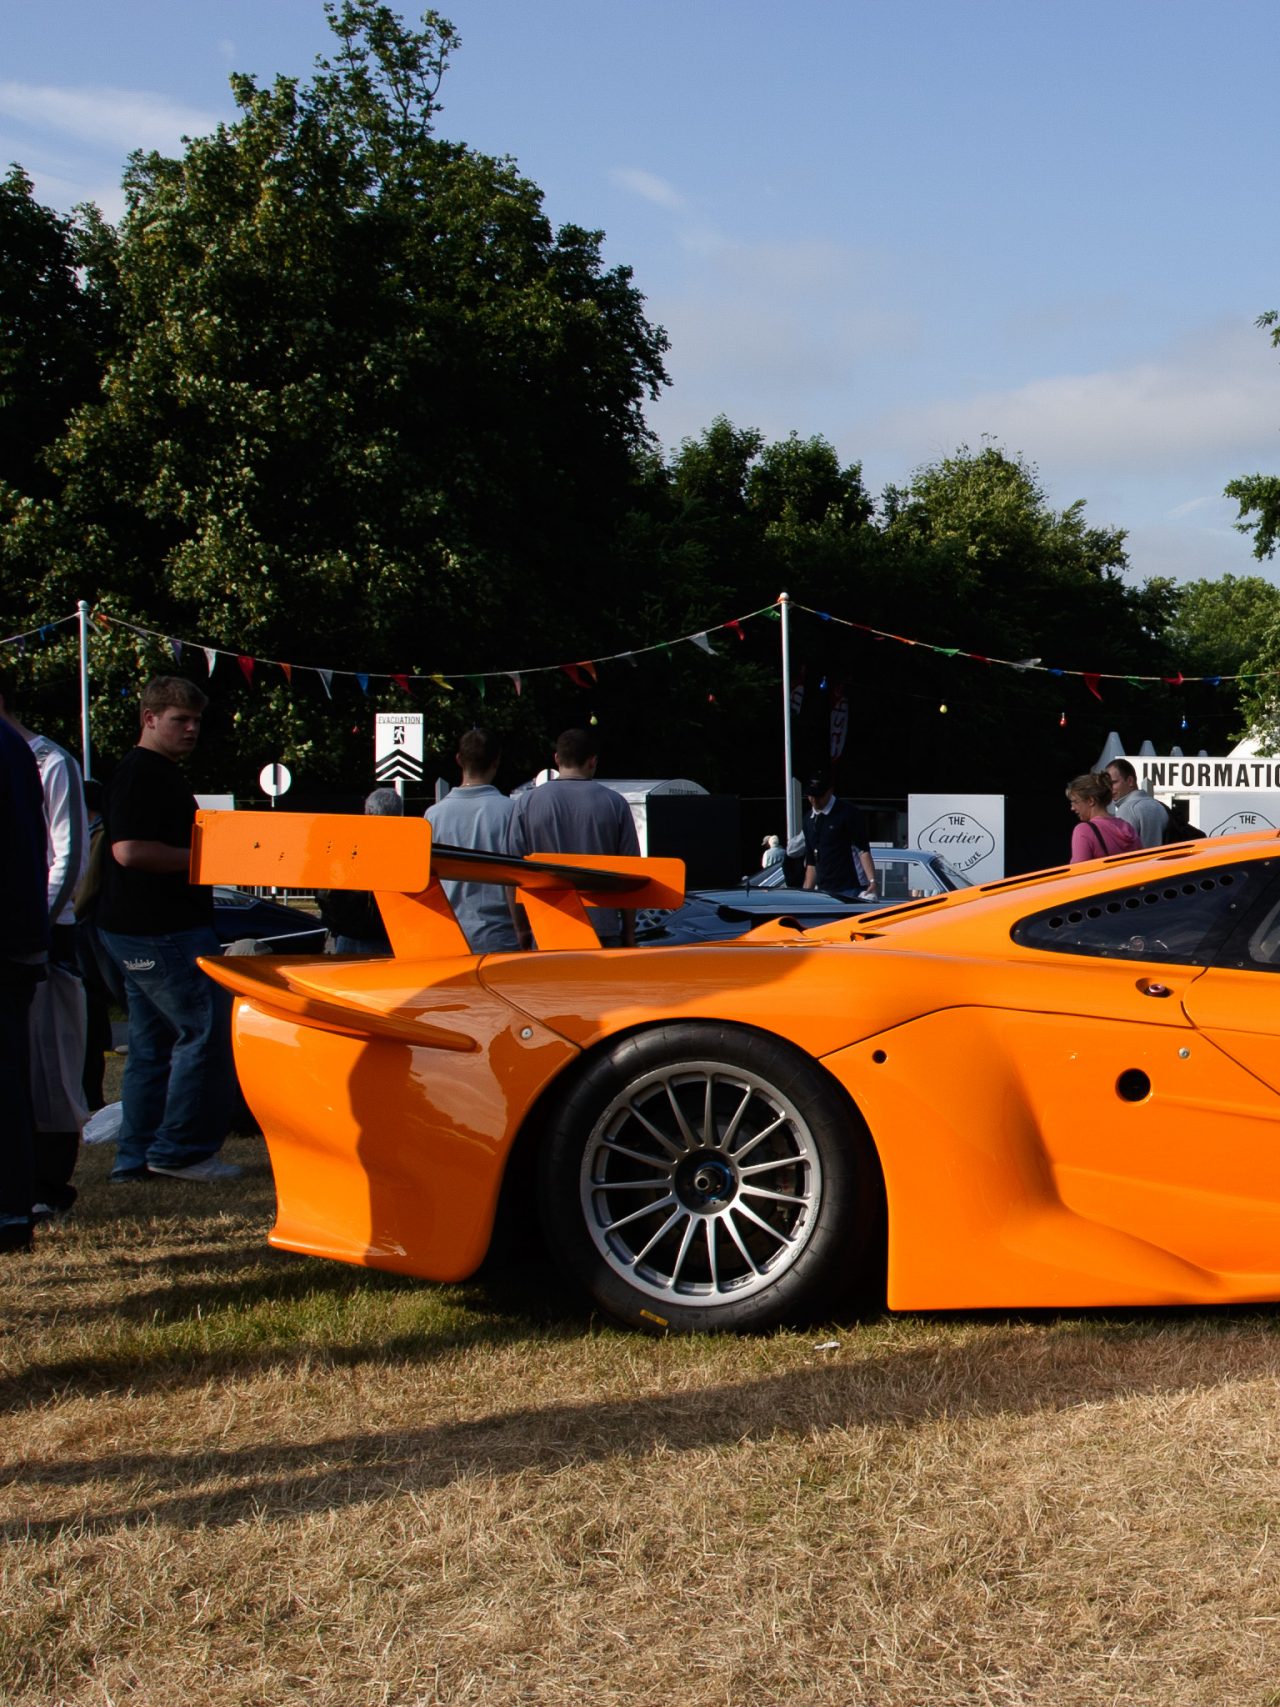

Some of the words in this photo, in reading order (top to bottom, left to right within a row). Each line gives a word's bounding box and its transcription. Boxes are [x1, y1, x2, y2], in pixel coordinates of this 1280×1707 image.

[378, 716, 420, 724] EVACUATION
[948, 816, 966, 825] THE
[1239, 815, 1257, 824] THE
[928, 827, 984, 844] Cartier
[964, 851, 982, 867] LUXE
